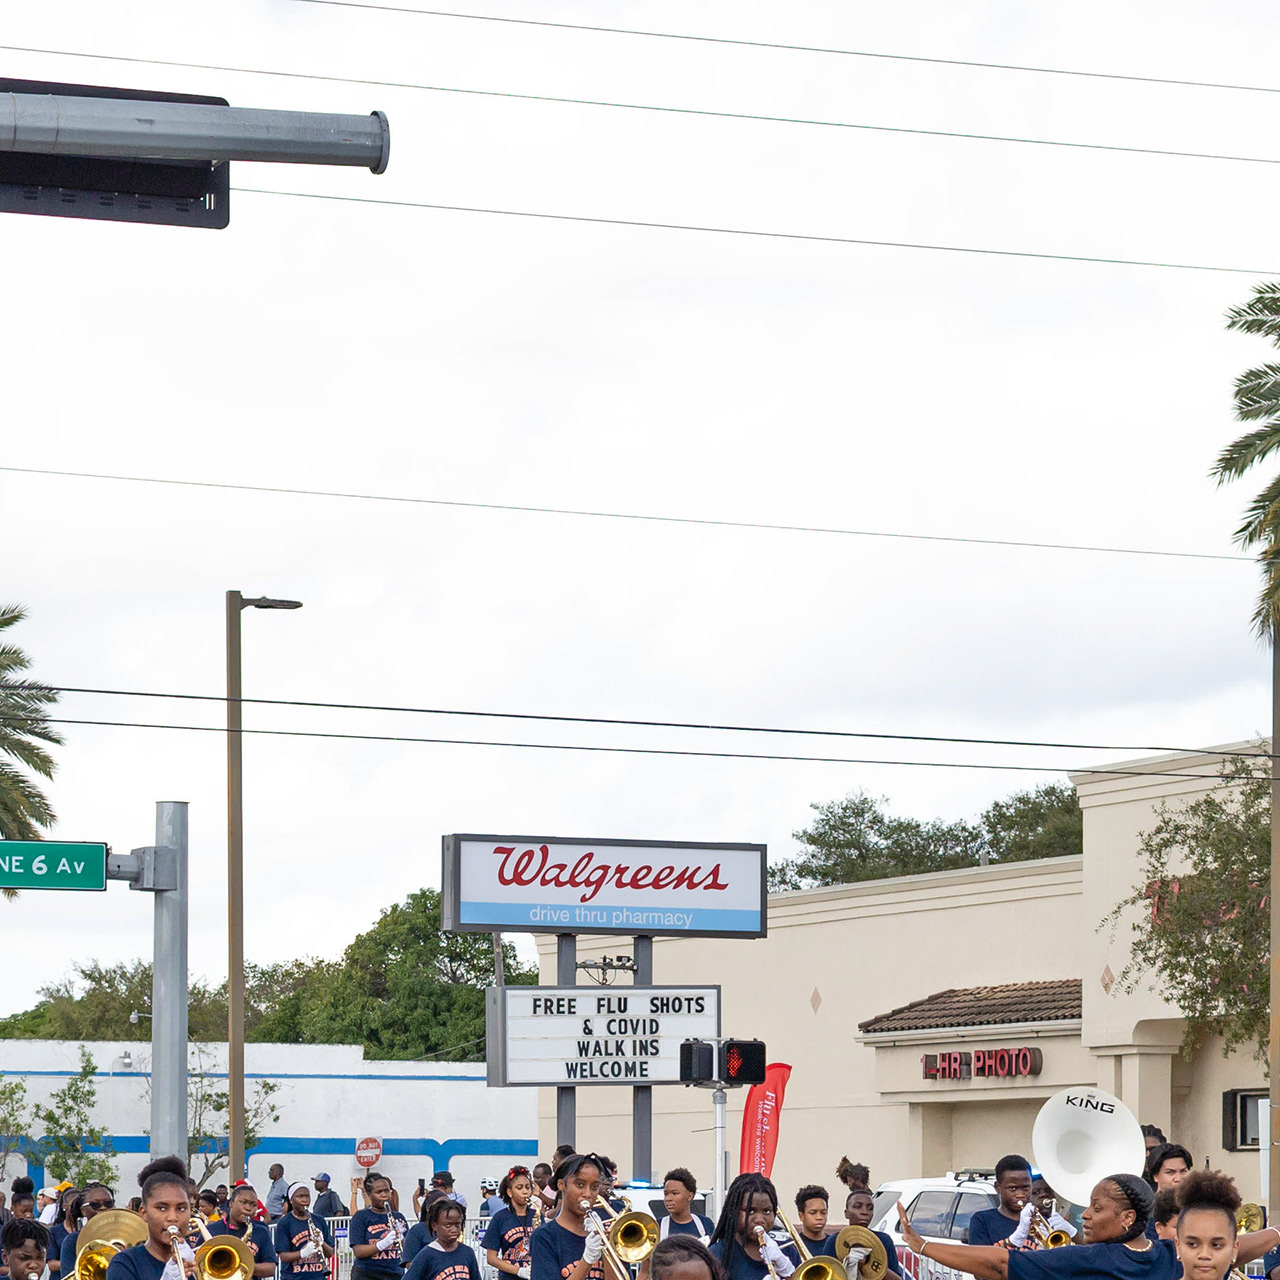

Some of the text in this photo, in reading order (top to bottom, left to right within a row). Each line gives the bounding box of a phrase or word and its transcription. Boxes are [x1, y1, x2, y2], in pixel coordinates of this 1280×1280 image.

[31, 854, 48, 876] 6
[57, 856, 85, 875] Av
[493, 844, 730, 904] Walgreens
[529, 905, 693, 929] drive thru pharmacy
[532, 996, 705, 1015] FREE FLU SHOTS
[582, 1018, 659, 1036] & COVID
[577, 1039, 660, 1057] WALK INS
[565, 1060, 649, 1079] WELCOME
[920, 1047, 1031, 1080] 1-HR PHOTO
[1066, 1095, 1115, 1114] KING
[293, 1263, 323, 1273] BAND
